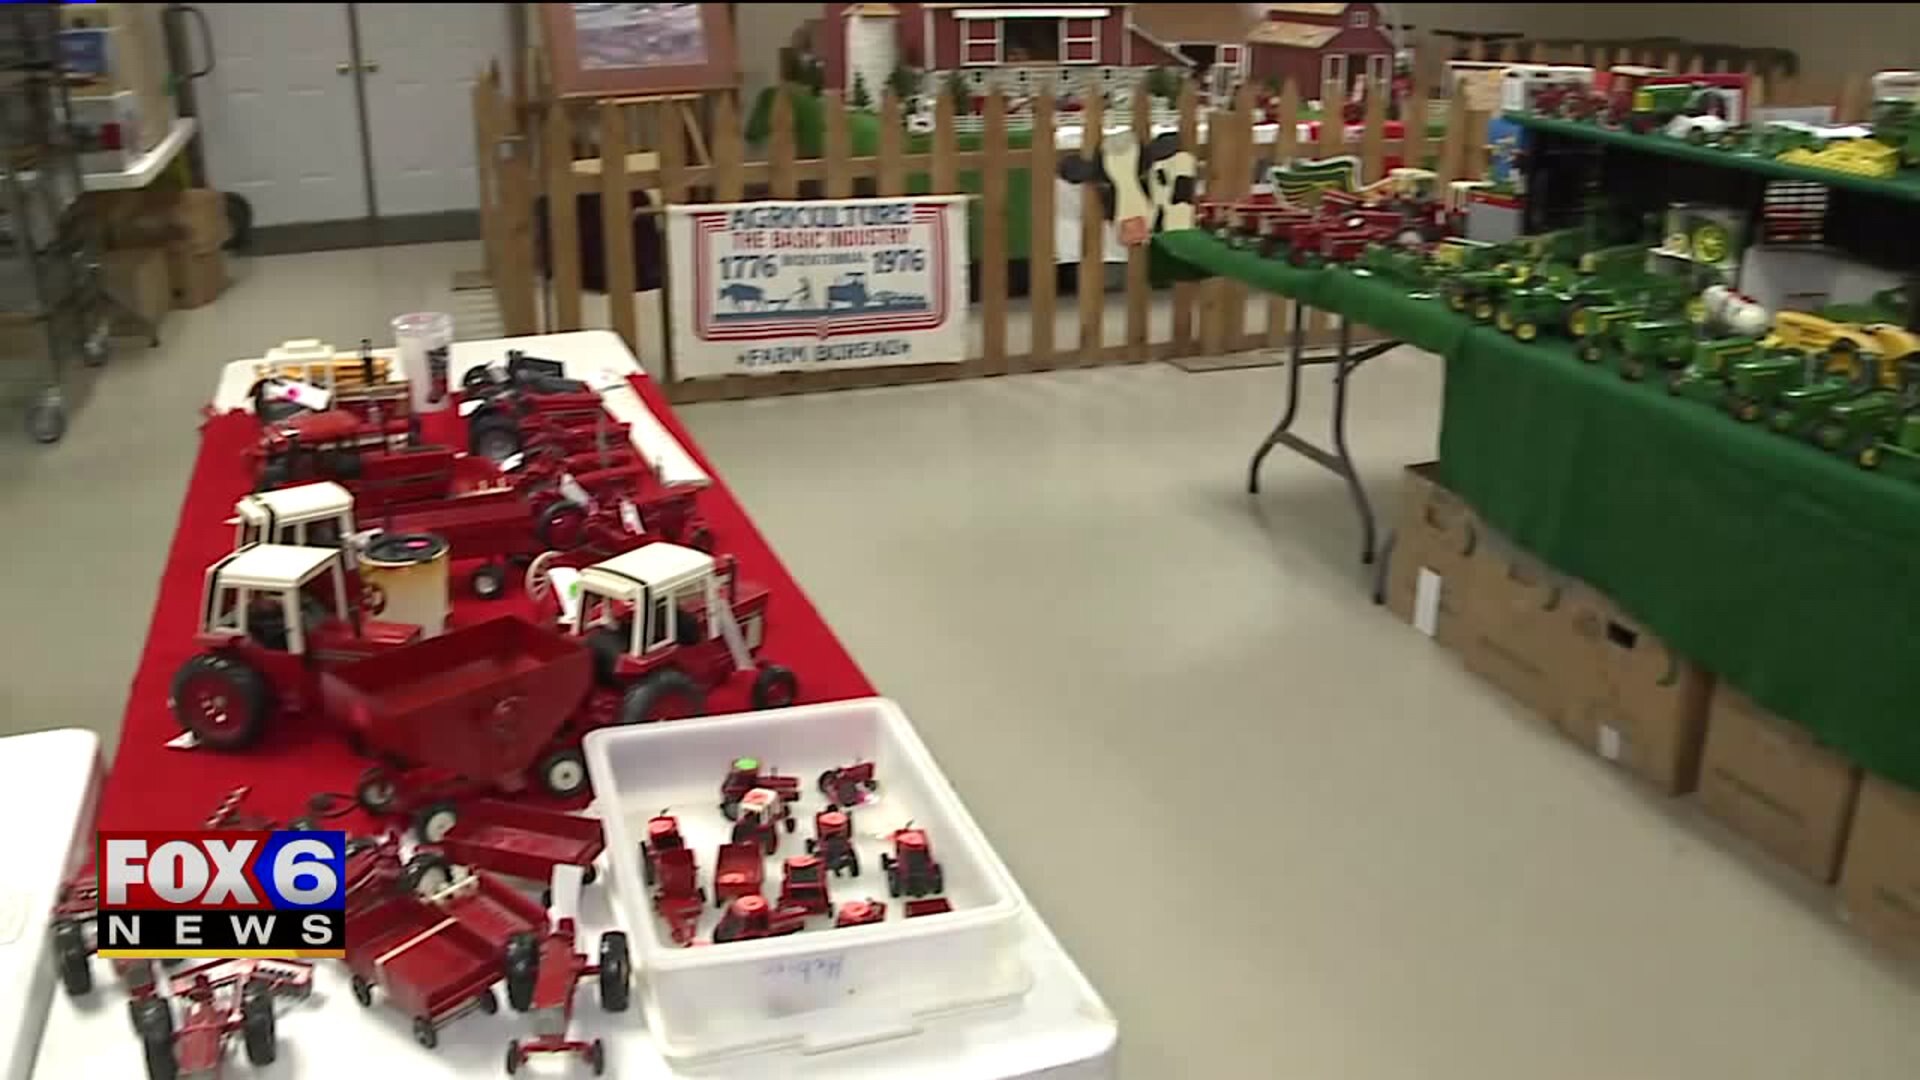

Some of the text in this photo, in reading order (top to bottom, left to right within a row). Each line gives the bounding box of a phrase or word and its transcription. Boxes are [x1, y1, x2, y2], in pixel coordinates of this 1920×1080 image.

[731, 204, 912, 229] AGRICULTURE
[733, 228, 911, 249] THE BASIC INDUSTRY
[719, 254, 779, 279] 1776
[872, 249, 925, 274] 1976
[747, 340, 902, 366] FARM BUREAU
